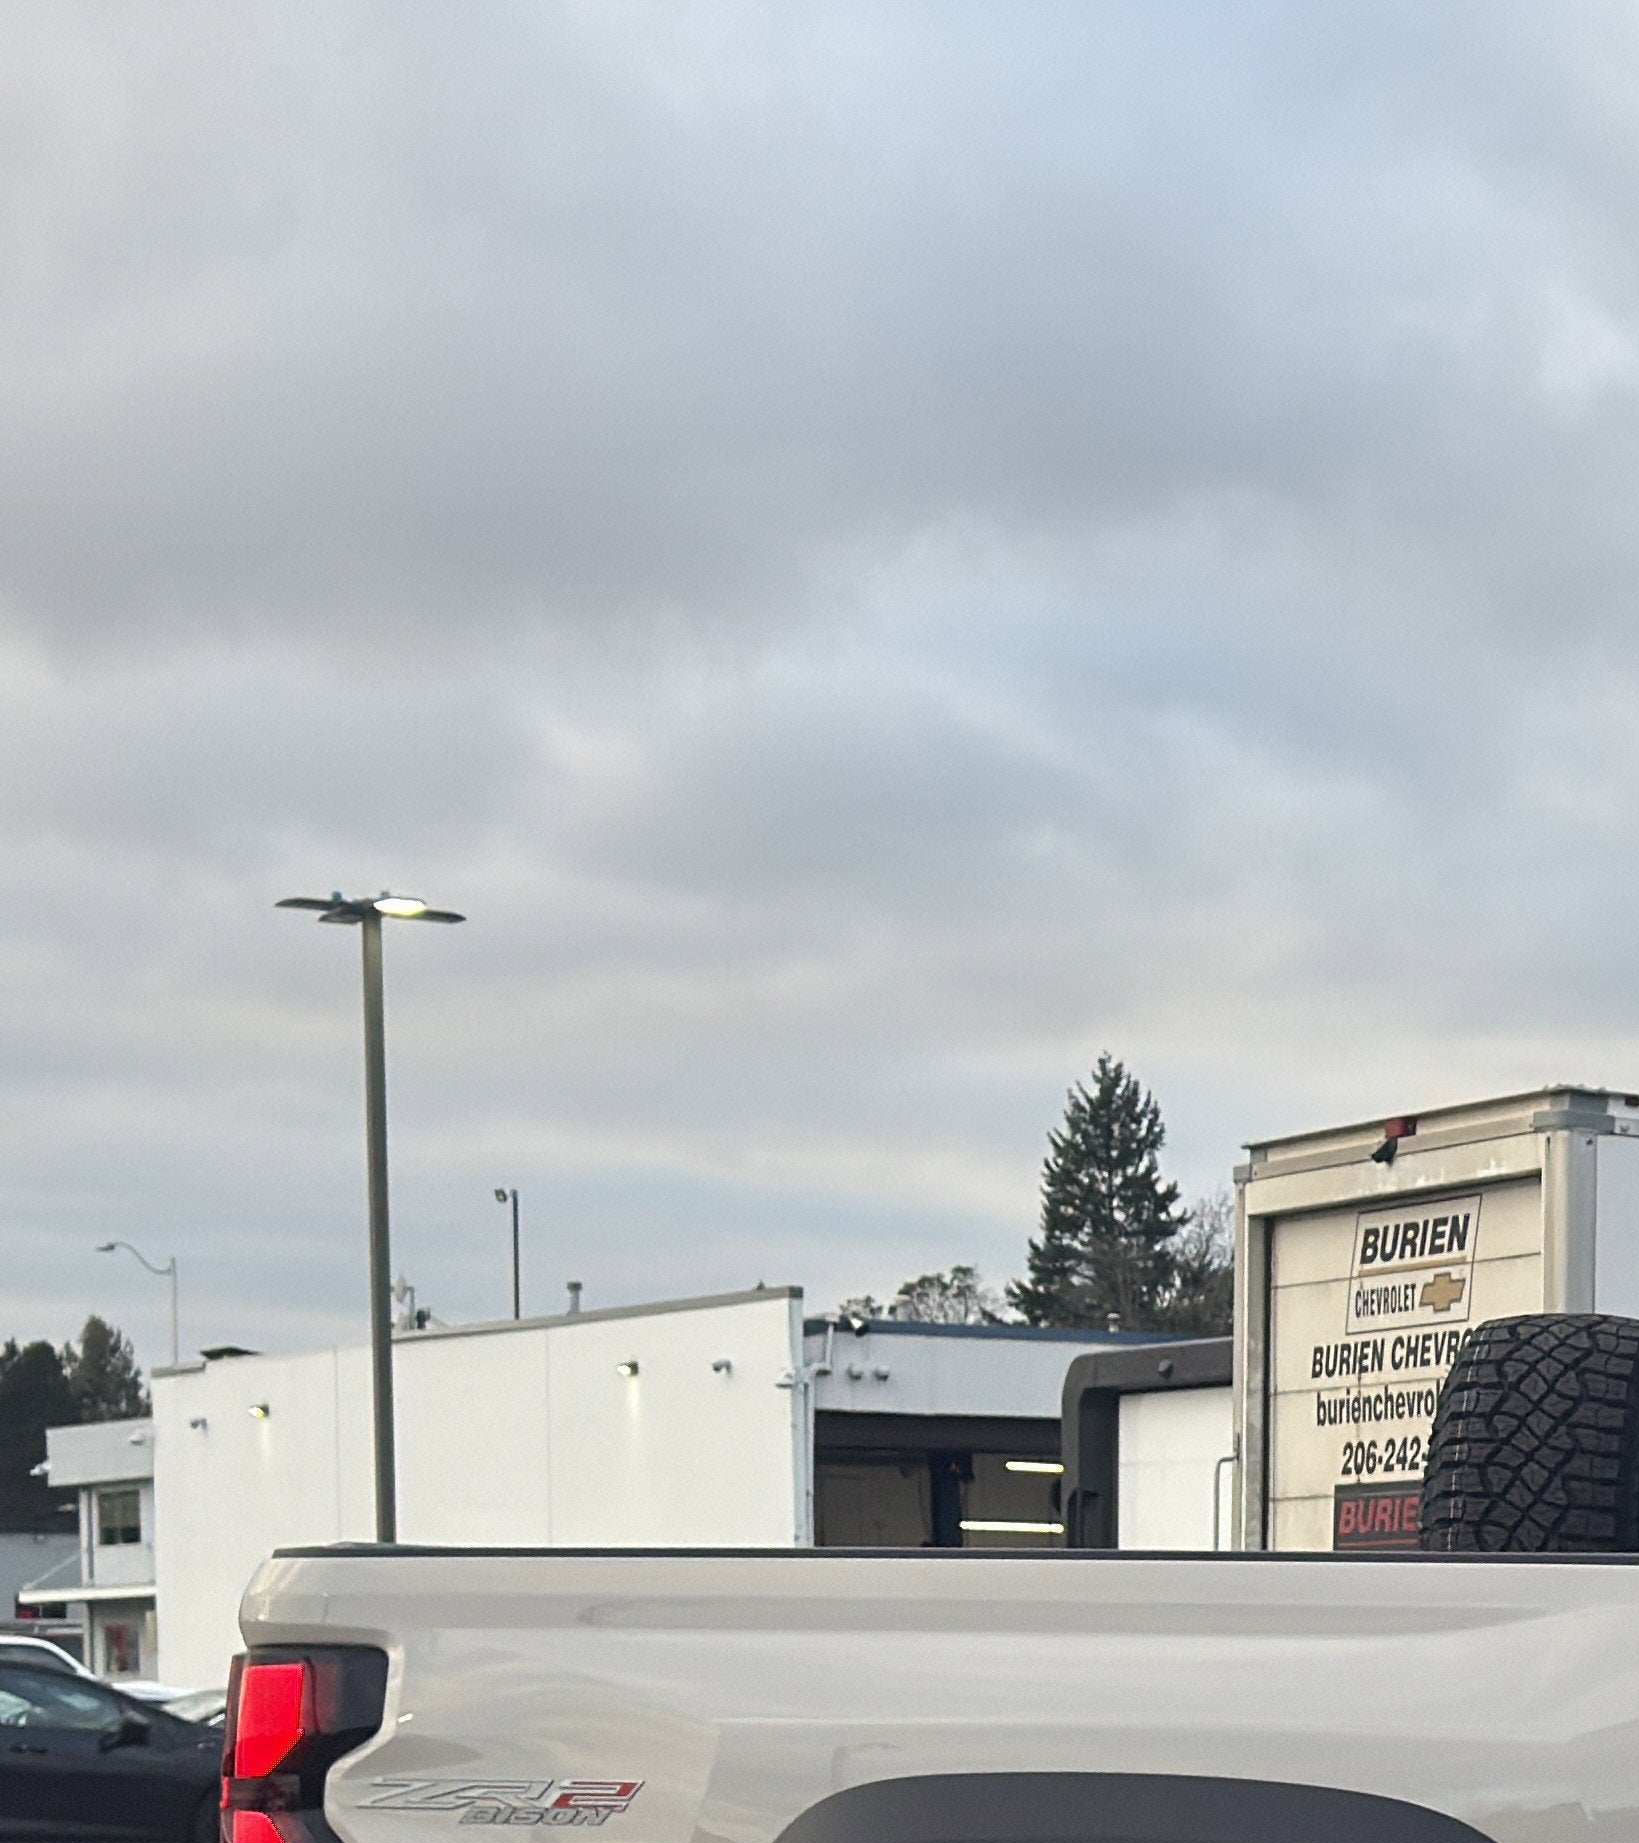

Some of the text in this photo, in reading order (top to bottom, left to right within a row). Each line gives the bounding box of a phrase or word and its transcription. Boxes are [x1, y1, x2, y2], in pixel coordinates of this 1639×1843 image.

[1360, 1213, 1470, 1265] BURIEN
[1355, 1283, 1417, 1318] CHEVROLET
[1311, 1337, 1385, 1380] BURIEN
[355, 1778, 645, 1811] ZR2
[458, 1806, 614, 1827] BISON
